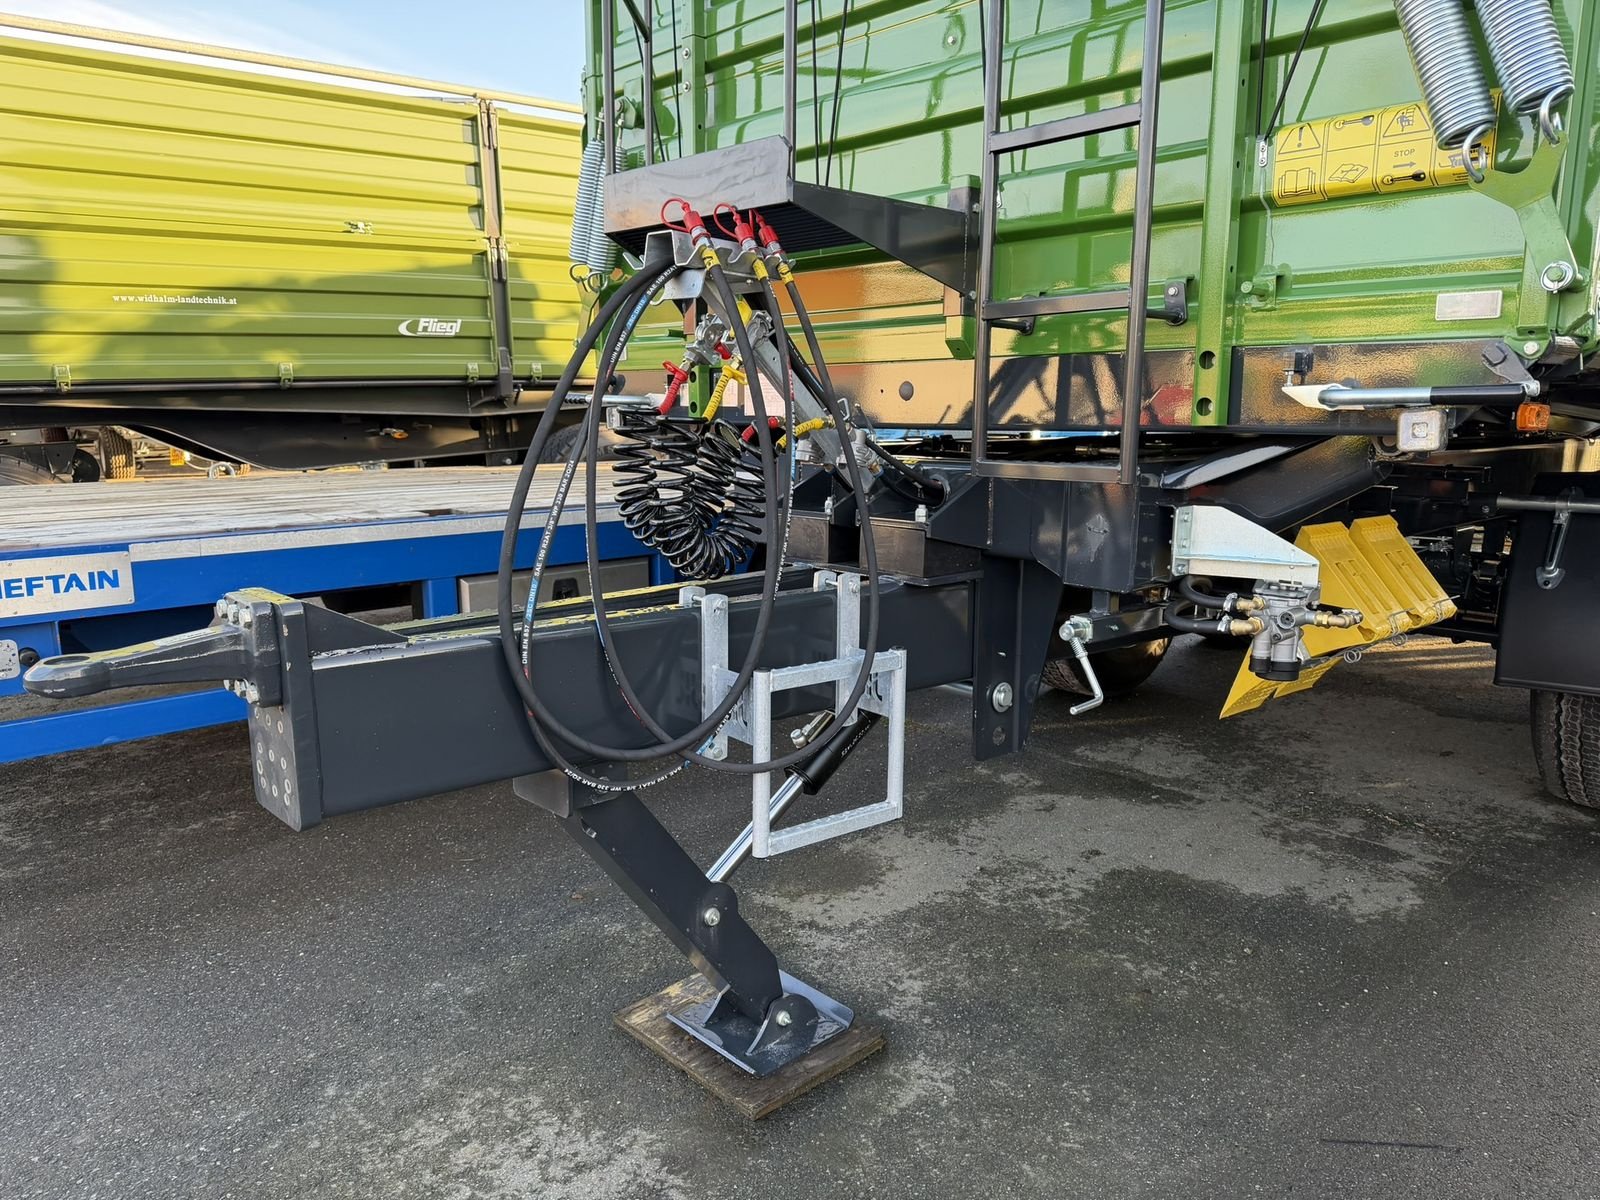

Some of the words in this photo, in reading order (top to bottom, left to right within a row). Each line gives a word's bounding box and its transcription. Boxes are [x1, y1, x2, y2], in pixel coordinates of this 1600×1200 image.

[1394, 149, 1415, 158] STOP
[112, 294, 238, 305] www.widhalm-landtechnik.at
[418, 318, 461, 336] Fliegl
[560, 478, 568, 492] BAR
[543, 531, 551, 548] R2AT
[538, 549, 546, 560] 100
[534, 562, 543, 576] SAE
[0, 569, 119, 599] EFTAIN
[522, 637, 528, 649] EN
